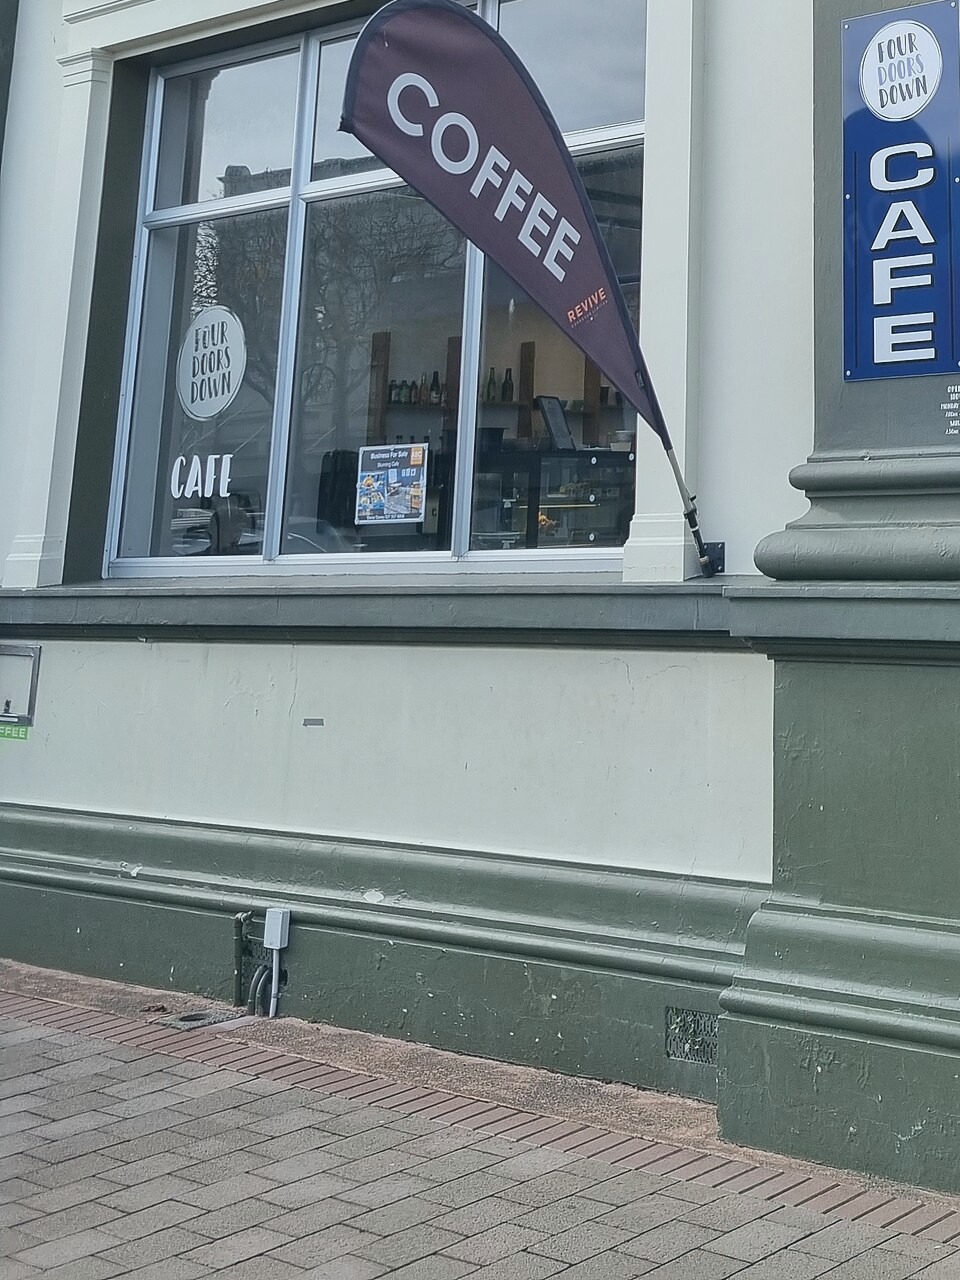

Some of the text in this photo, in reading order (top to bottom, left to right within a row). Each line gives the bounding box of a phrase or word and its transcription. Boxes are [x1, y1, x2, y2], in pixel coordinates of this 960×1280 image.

[877, 32, 918, 63] FOUR
[877, 59, 925, 86] DOORS
[879, 75, 928, 108] DOWN
[386, 72, 582, 282] COFFEE
[869, 142, 936, 365] CAFE
[567, 287, 607, 323] REVIVE
[194, 321, 228, 352] FOUR
[192, 346, 231, 379] DOORS
[190, 371, 231, 404] DOWN
[170, 454, 234, 498] CAFE
